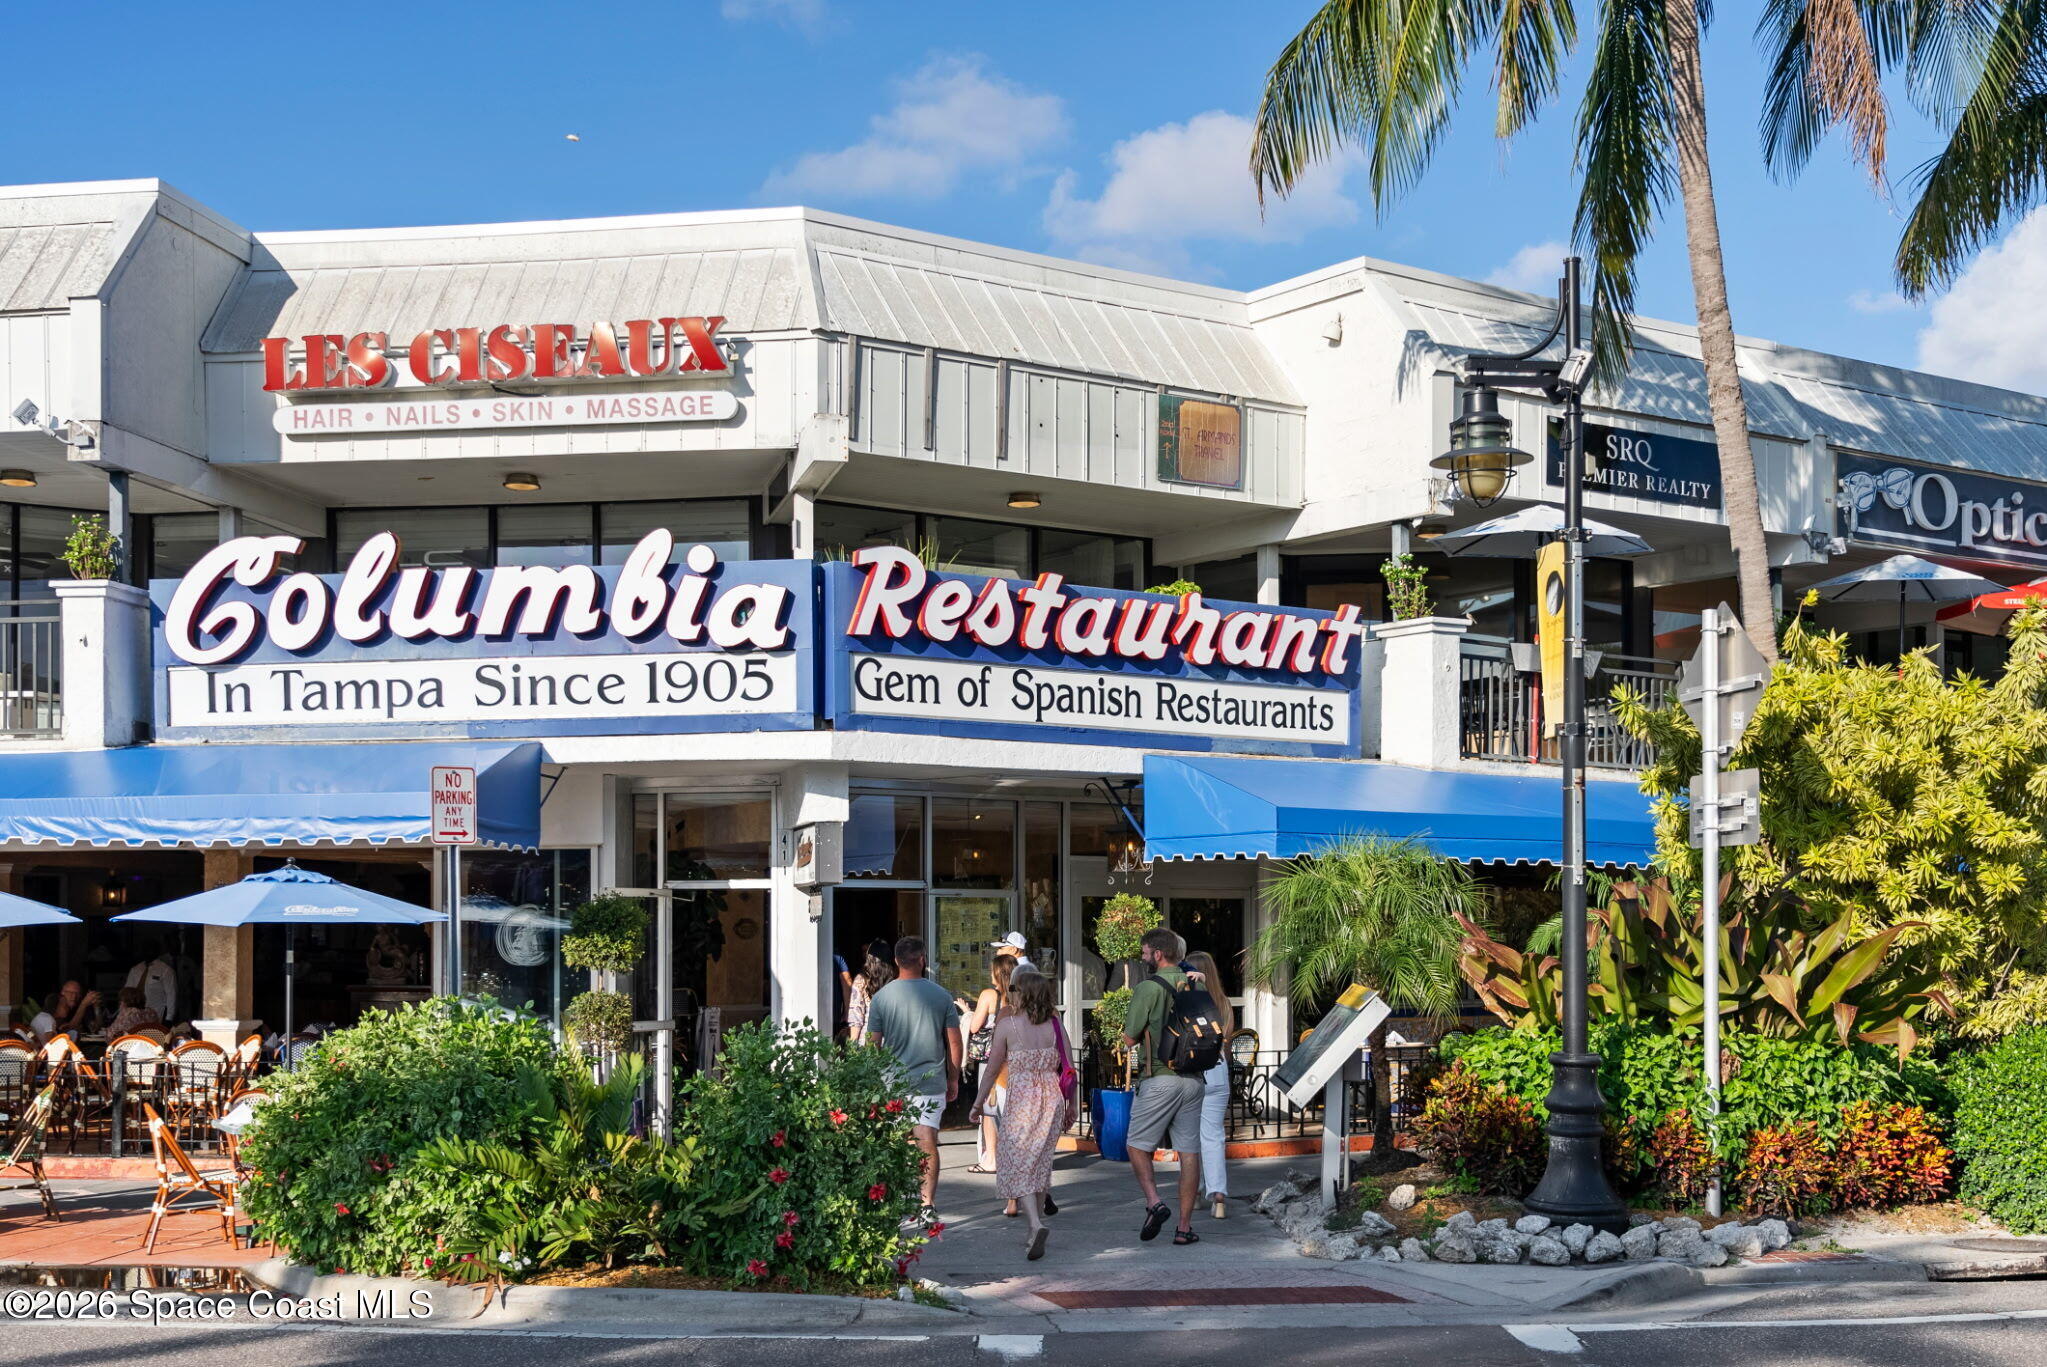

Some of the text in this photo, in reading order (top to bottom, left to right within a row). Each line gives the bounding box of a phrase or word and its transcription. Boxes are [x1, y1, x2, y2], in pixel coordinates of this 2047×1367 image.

[260, 316, 729, 391] LES CISEAUX
[293, 394, 714, 429] HAIR NAILS SKIN MASSAGE
[1606, 434, 1660, 471] SRQ
[1646, 475, 1711, 499] REALTY
[165, 528, 794, 665] Columbia
[846, 545, 1362, 675] Restaurant
[206, 659, 774, 718] In Tampa Since 1905
[854, 657, 1334, 731] Gem of Spanish Restaurants
[434, 790, 473, 805] PARKING
[445, 773, 462, 788] NO
[444, 817, 464, 828] TIME
[445, 806, 463, 817] ANY
